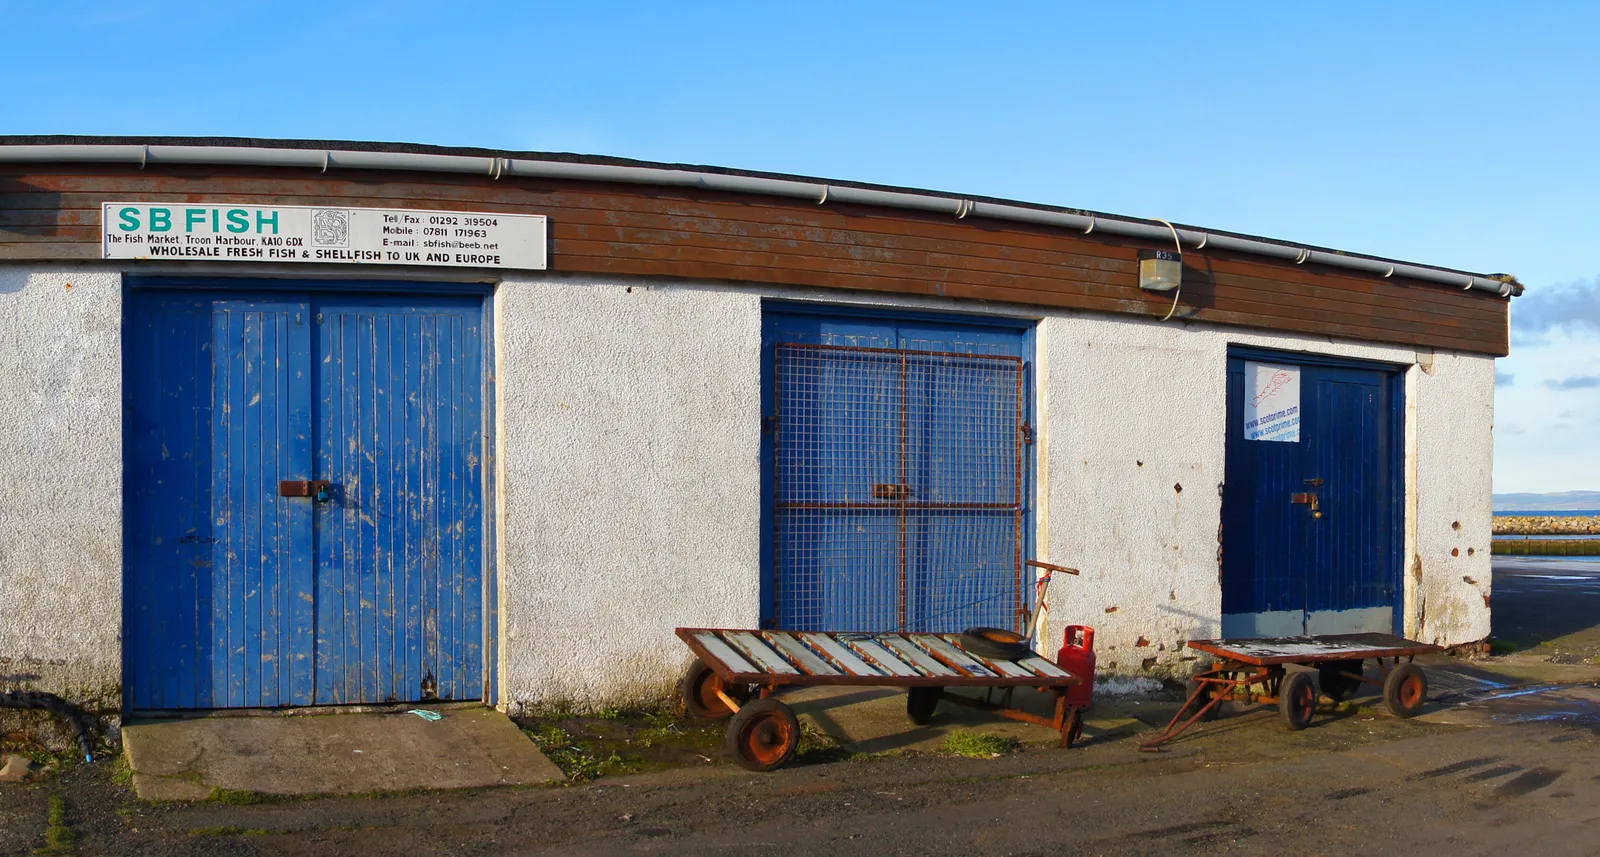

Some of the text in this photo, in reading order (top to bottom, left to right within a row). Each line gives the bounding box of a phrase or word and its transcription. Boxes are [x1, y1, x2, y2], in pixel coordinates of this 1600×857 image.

[118, 207, 279, 234] SB FISH
[429, 215, 458, 225] 01292
[464, 217, 498, 227] 319504
[423, 228, 448, 237] 07811
[454, 229, 487, 238] 171963
[108, 234, 122, 244] The
[125, 234, 143, 244] Fish
[185, 235, 211, 245] Troon
[261, 236, 283, 246] KA10
[285, 237, 303, 247] 6DX
[423, 239, 499, 250] sbfish@beeb.net
[150, 246, 500, 264] WHOLESALE FRESH FISH & SHELLFISH TO UK AND EUROPE
[1156, 250, 1173, 260] R35
[1245, 406, 1298, 429] www.scotprime.com
